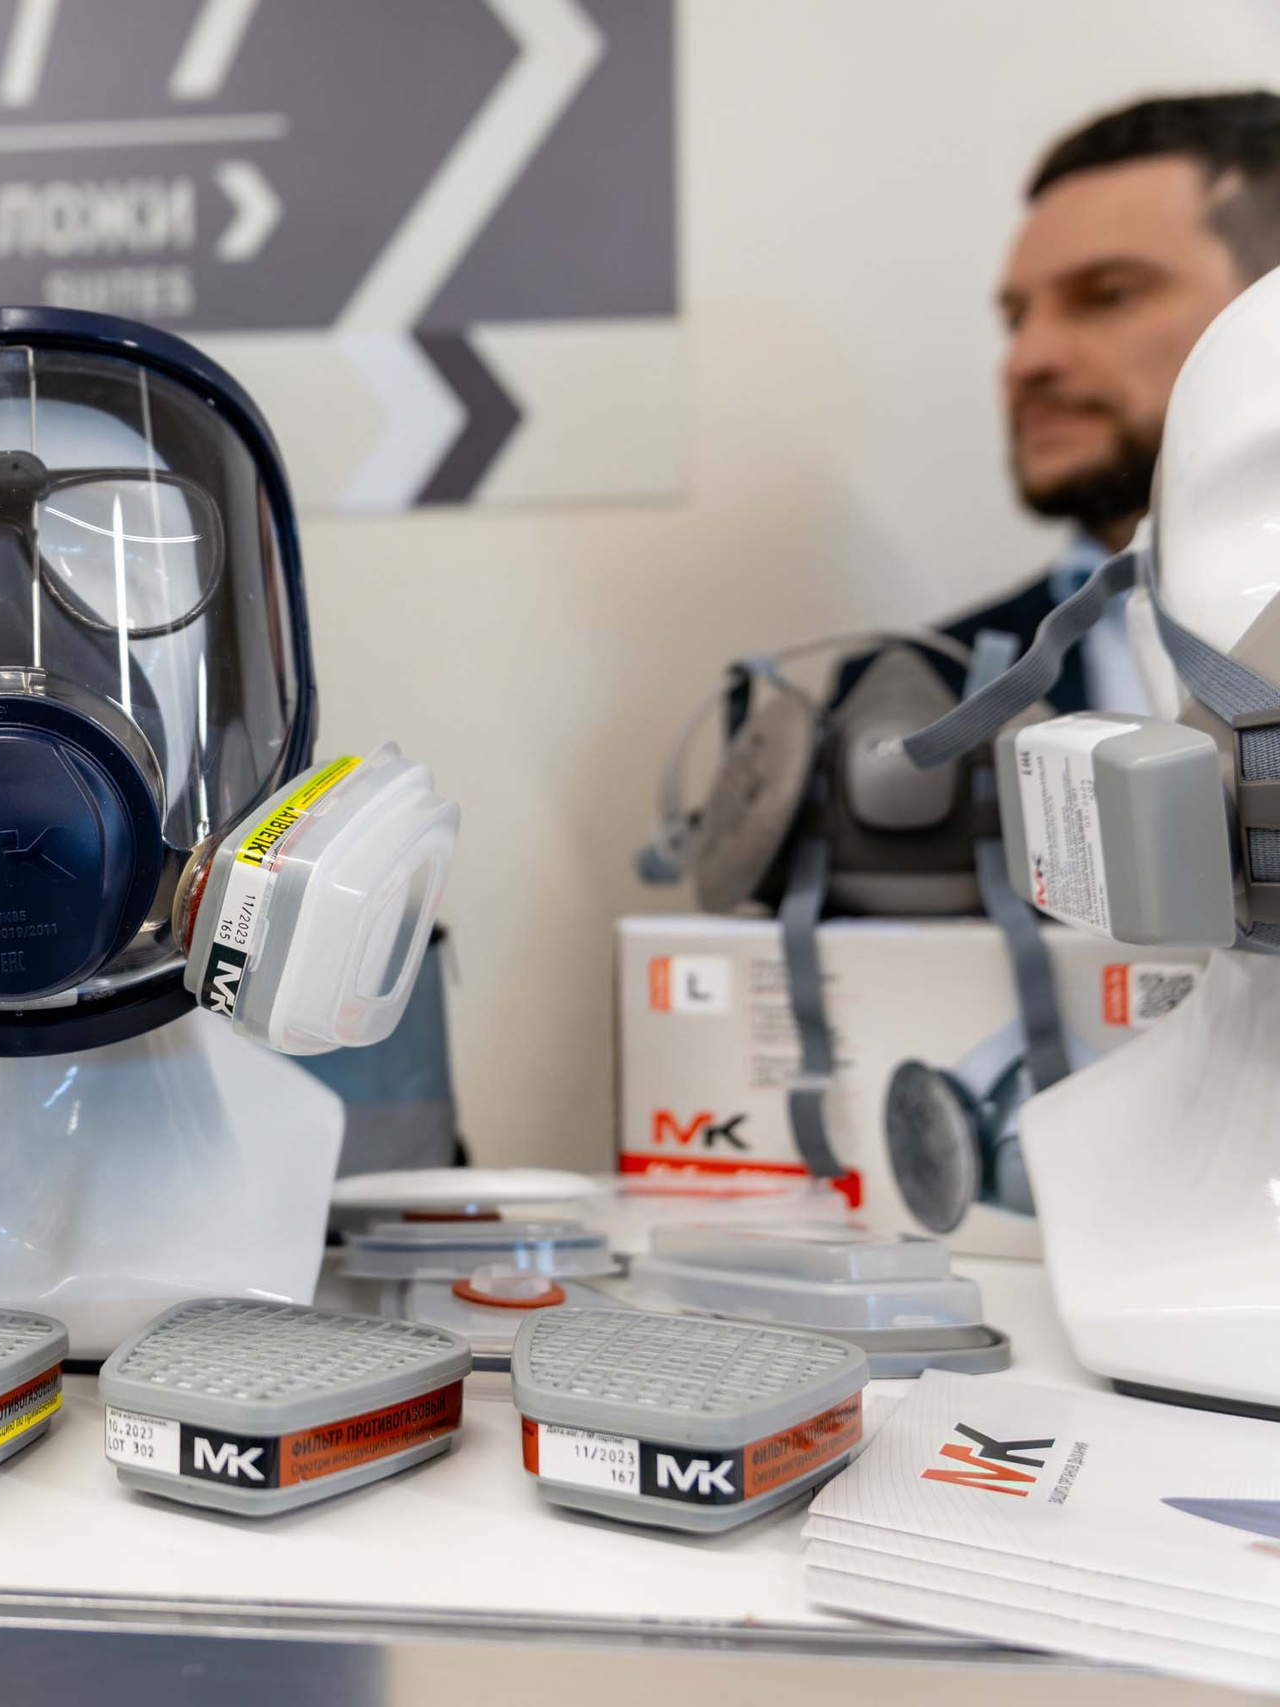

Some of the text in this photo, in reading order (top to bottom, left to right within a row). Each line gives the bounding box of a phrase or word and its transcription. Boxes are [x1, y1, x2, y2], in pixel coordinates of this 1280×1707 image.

[220, 919, 233, 941] 165
[235, 895, 255, 945] 11/2023
[687, 972, 711, 1001] L
[652, 1109, 750, 1151] MK
[24, 1396, 58, 1424] применению
[292, 1392, 446, 1458] ФИЛЬТР ПРОТИВОГАЗОВЫЙ
[109, 1419, 153, 1440] 10.2023
[108, 1436, 154, 1458] LOT 302
[194, 1437, 265, 1481] MK
[291, 1458, 330, 1476] Смотри
[333, 1440, 388, 1464] инструкцию
[389, 1436, 400, 1447] по
[575, 1444, 635, 1465] 11/2023
[753, 1435, 790, 1466] ФИЛЬТР
[921, 1422, 1056, 1498] MK
[612, 1469, 635, 1484] 167
[656, 1453, 735, 1494] MK
